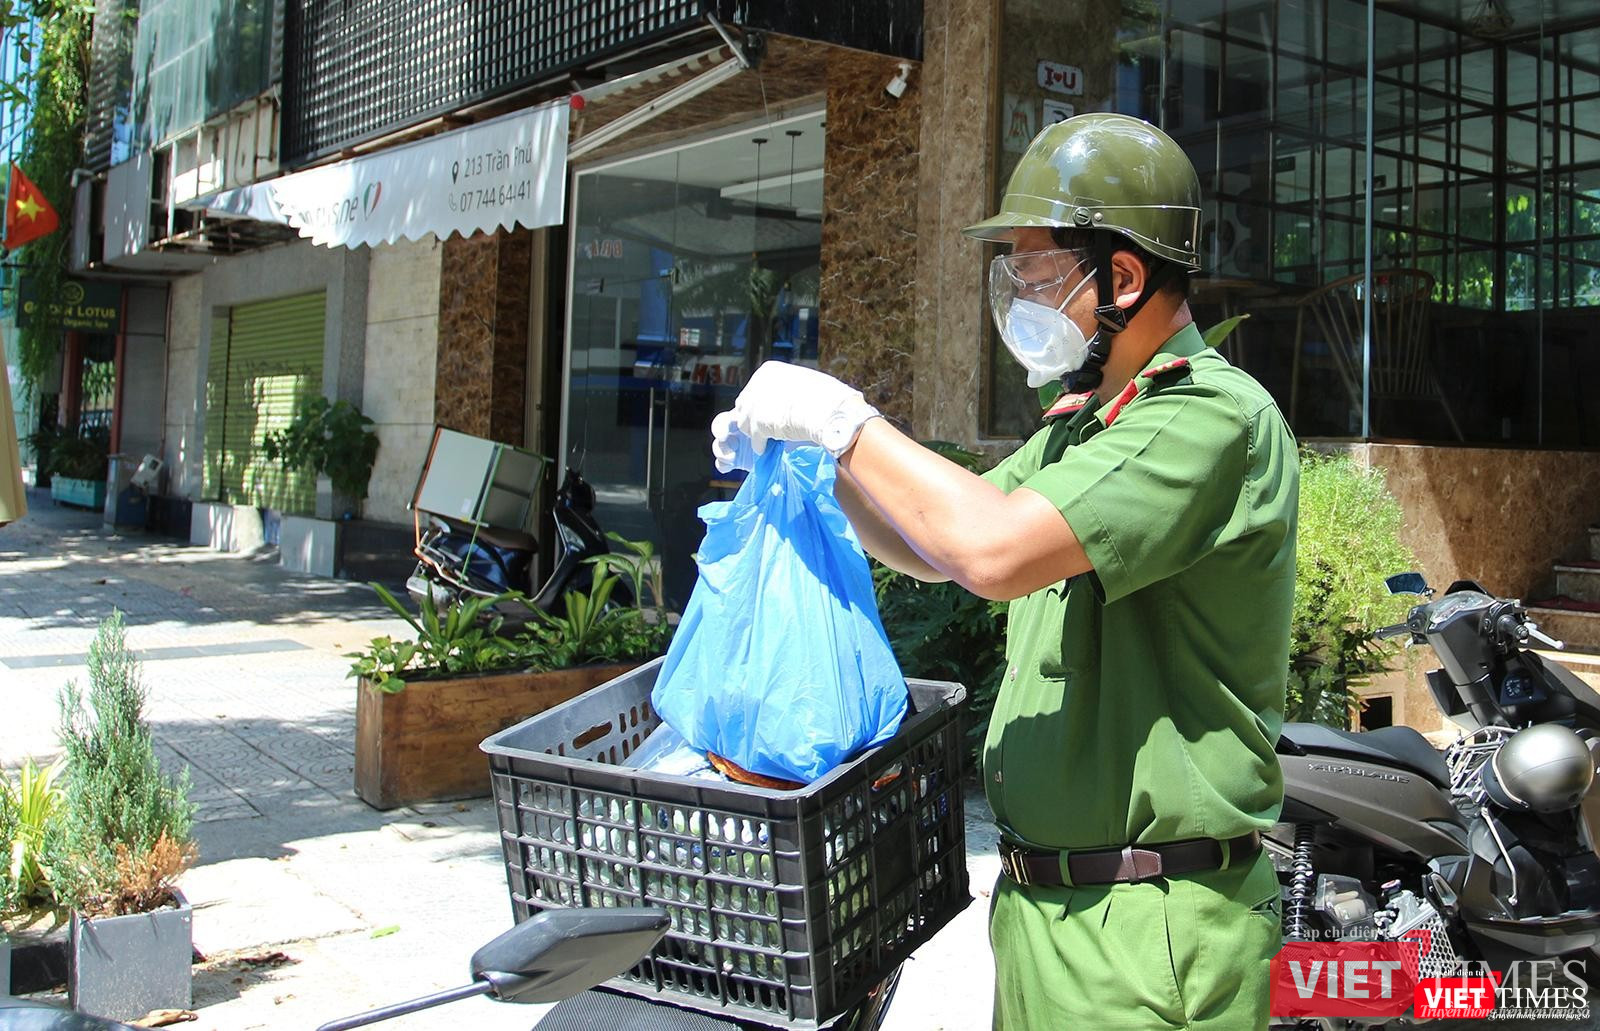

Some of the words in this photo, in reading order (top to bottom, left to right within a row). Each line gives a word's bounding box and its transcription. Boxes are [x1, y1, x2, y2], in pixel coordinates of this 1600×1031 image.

[464, 155, 483, 178] 213
[460, 191, 474, 213] 07
[476, 187, 496, 209] 744
[77, 304, 117, 319] LOTUS
